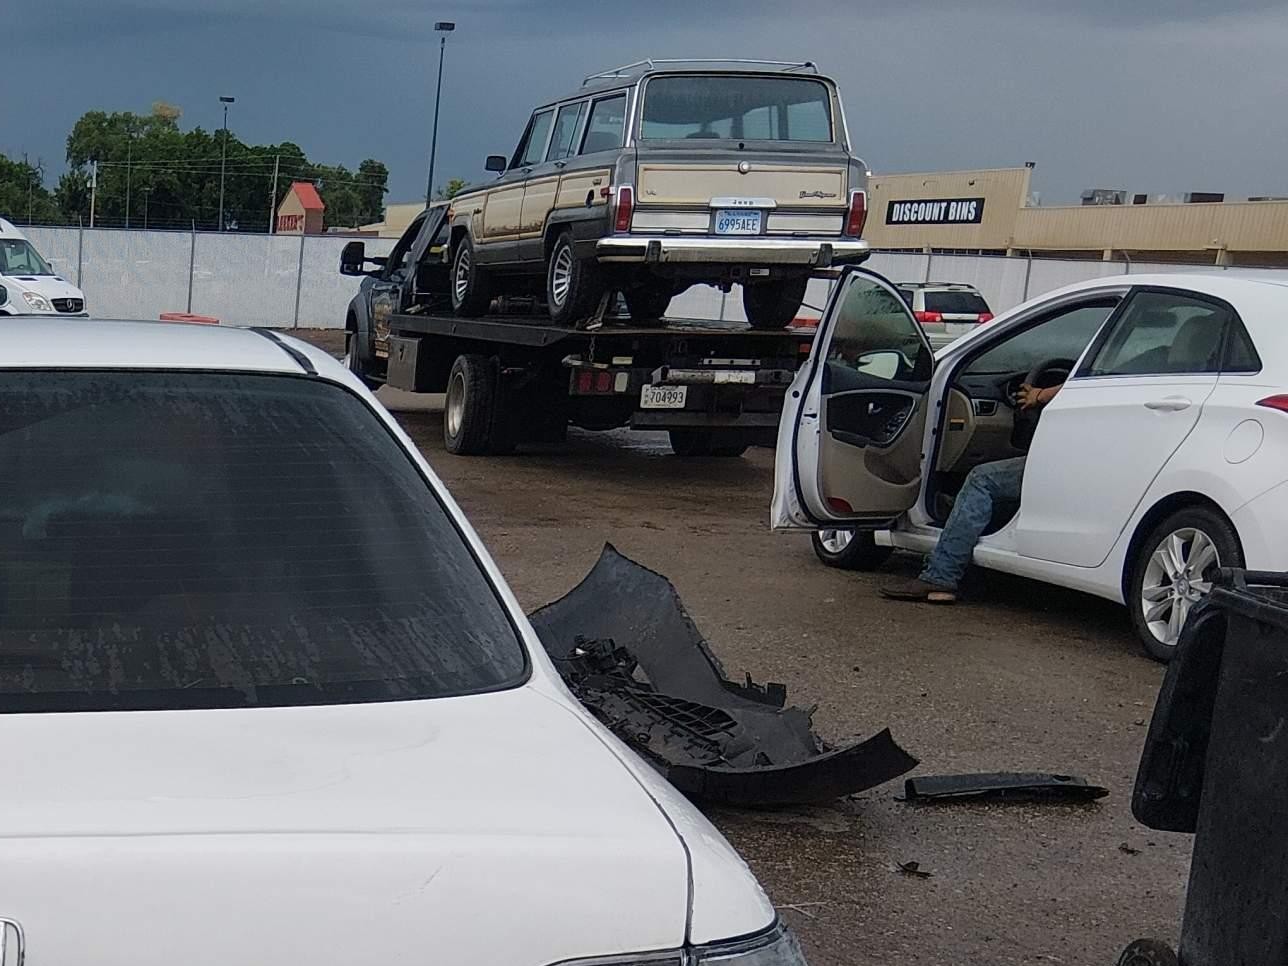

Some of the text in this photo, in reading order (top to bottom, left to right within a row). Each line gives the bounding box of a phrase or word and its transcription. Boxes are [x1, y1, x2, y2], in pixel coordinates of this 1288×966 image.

[892, 201, 976, 222] DISCOUNT BINS
[718, 218, 758, 231] 6995AEE
